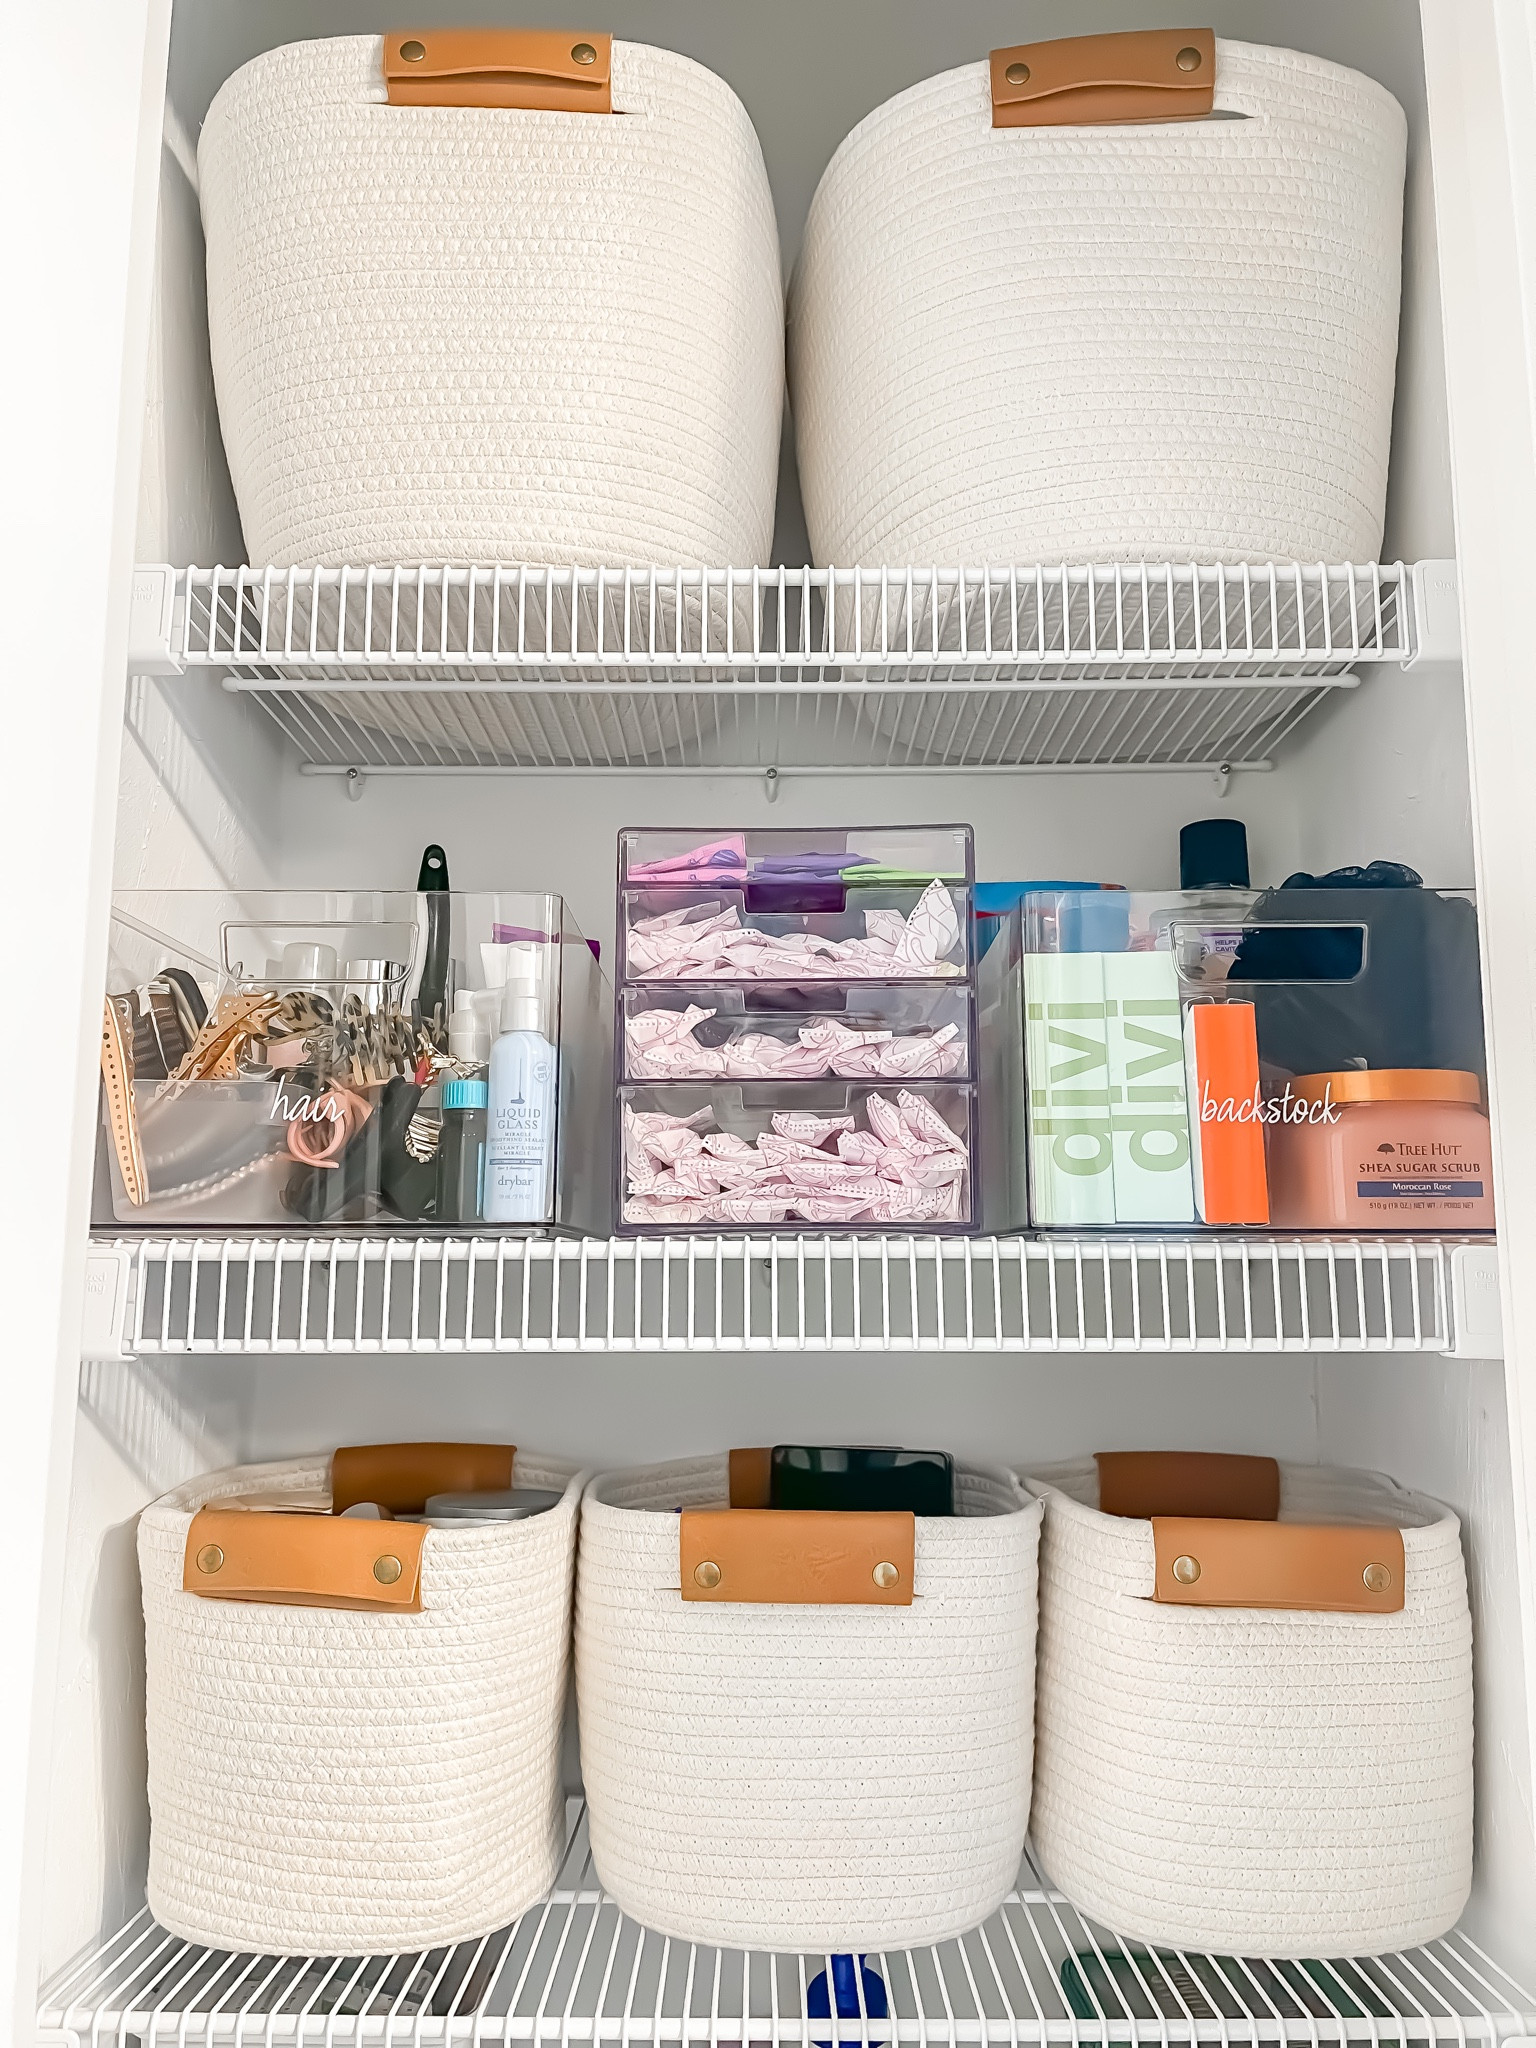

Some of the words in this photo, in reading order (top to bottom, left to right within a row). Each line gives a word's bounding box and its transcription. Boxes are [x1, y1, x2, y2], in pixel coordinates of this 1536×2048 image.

[1029, 1003, 1113, 1176] divi
[1105, 1000, 1189, 1172] divi
[270, 1074, 345, 1122] hair
[1201, 1080, 1342, 1124] backstock
[497, 1108, 541, 1120] LIQUID
[497, 1120, 538, 1129] GLASS
[1396, 1143, 1428, 1155] TREE
[1431, 1143, 1462, 1155] HUT
[1360, 1163, 1392, 1173] SHEA
[1396, 1163, 1438, 1173] SUGAR
[1441, 1163, 1481, 1173] SCRUB
[498, 1175, 534, 1190] drybar
[1392, 1183, 1432, 1191] Moroccan
